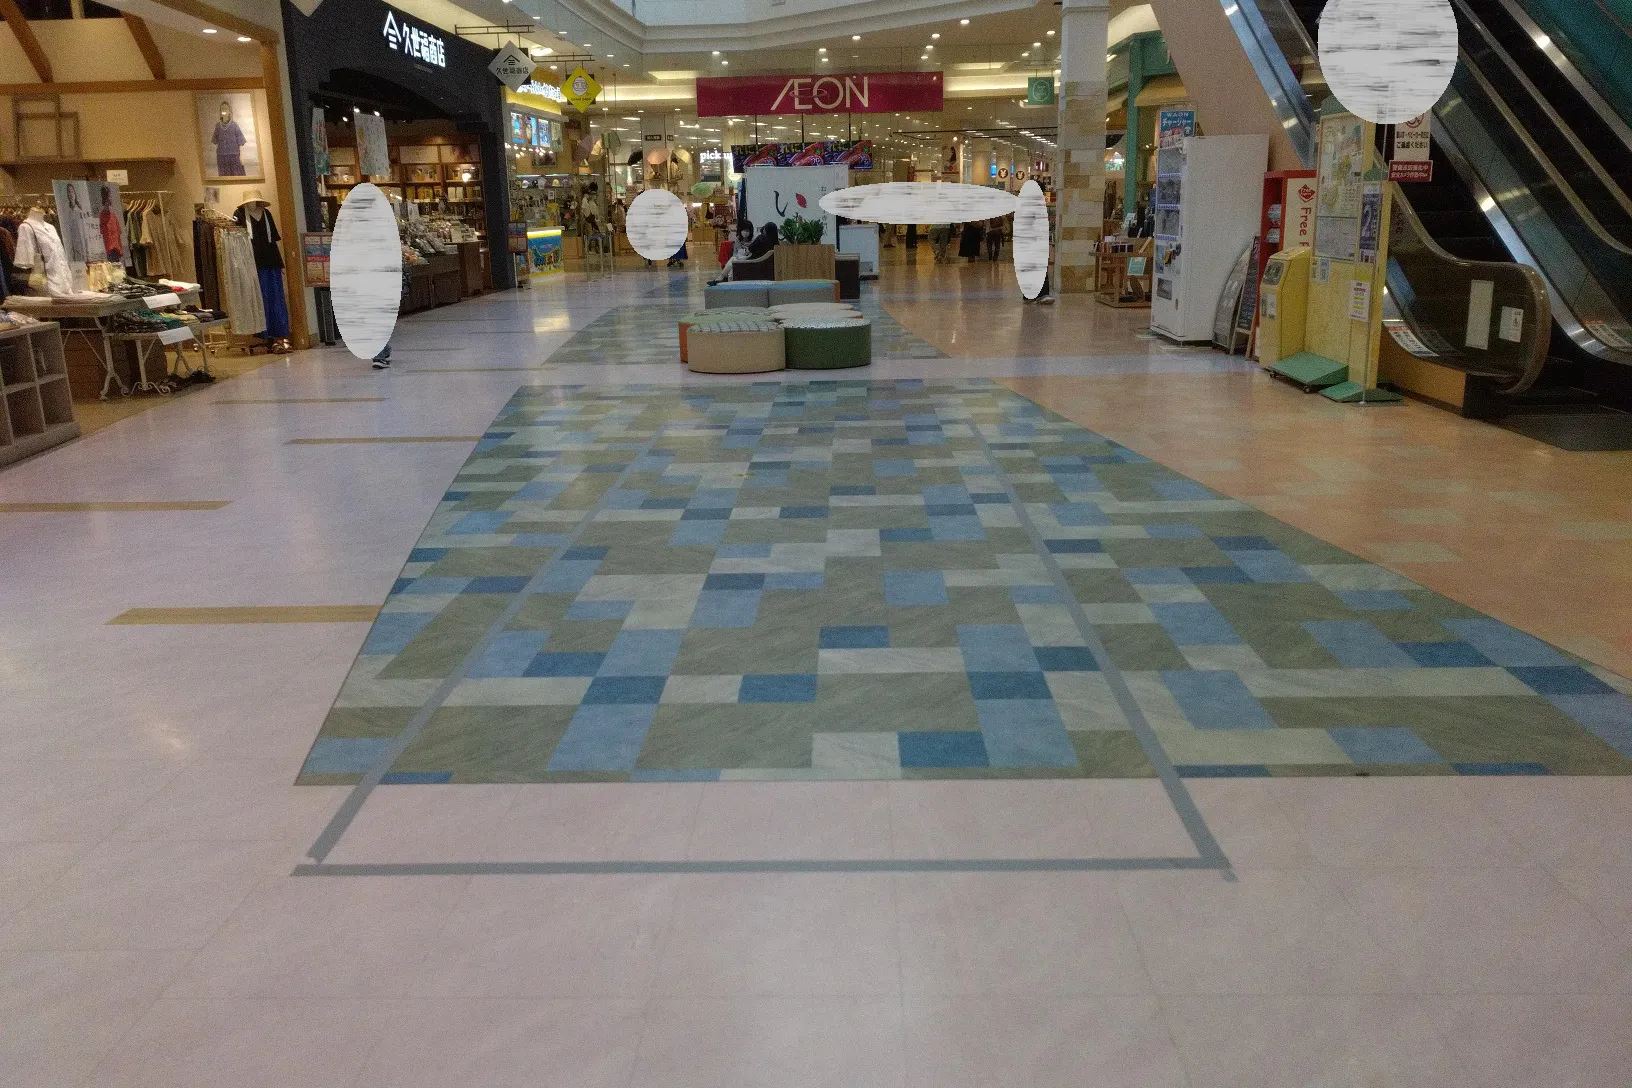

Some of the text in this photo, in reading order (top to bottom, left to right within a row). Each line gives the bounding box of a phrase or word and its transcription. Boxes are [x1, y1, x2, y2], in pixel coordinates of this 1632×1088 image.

[403, 22, 446, 67] 久世福商店
[700, 150, 721, 163] pick
[1299, 207, 1312, 236] Free
